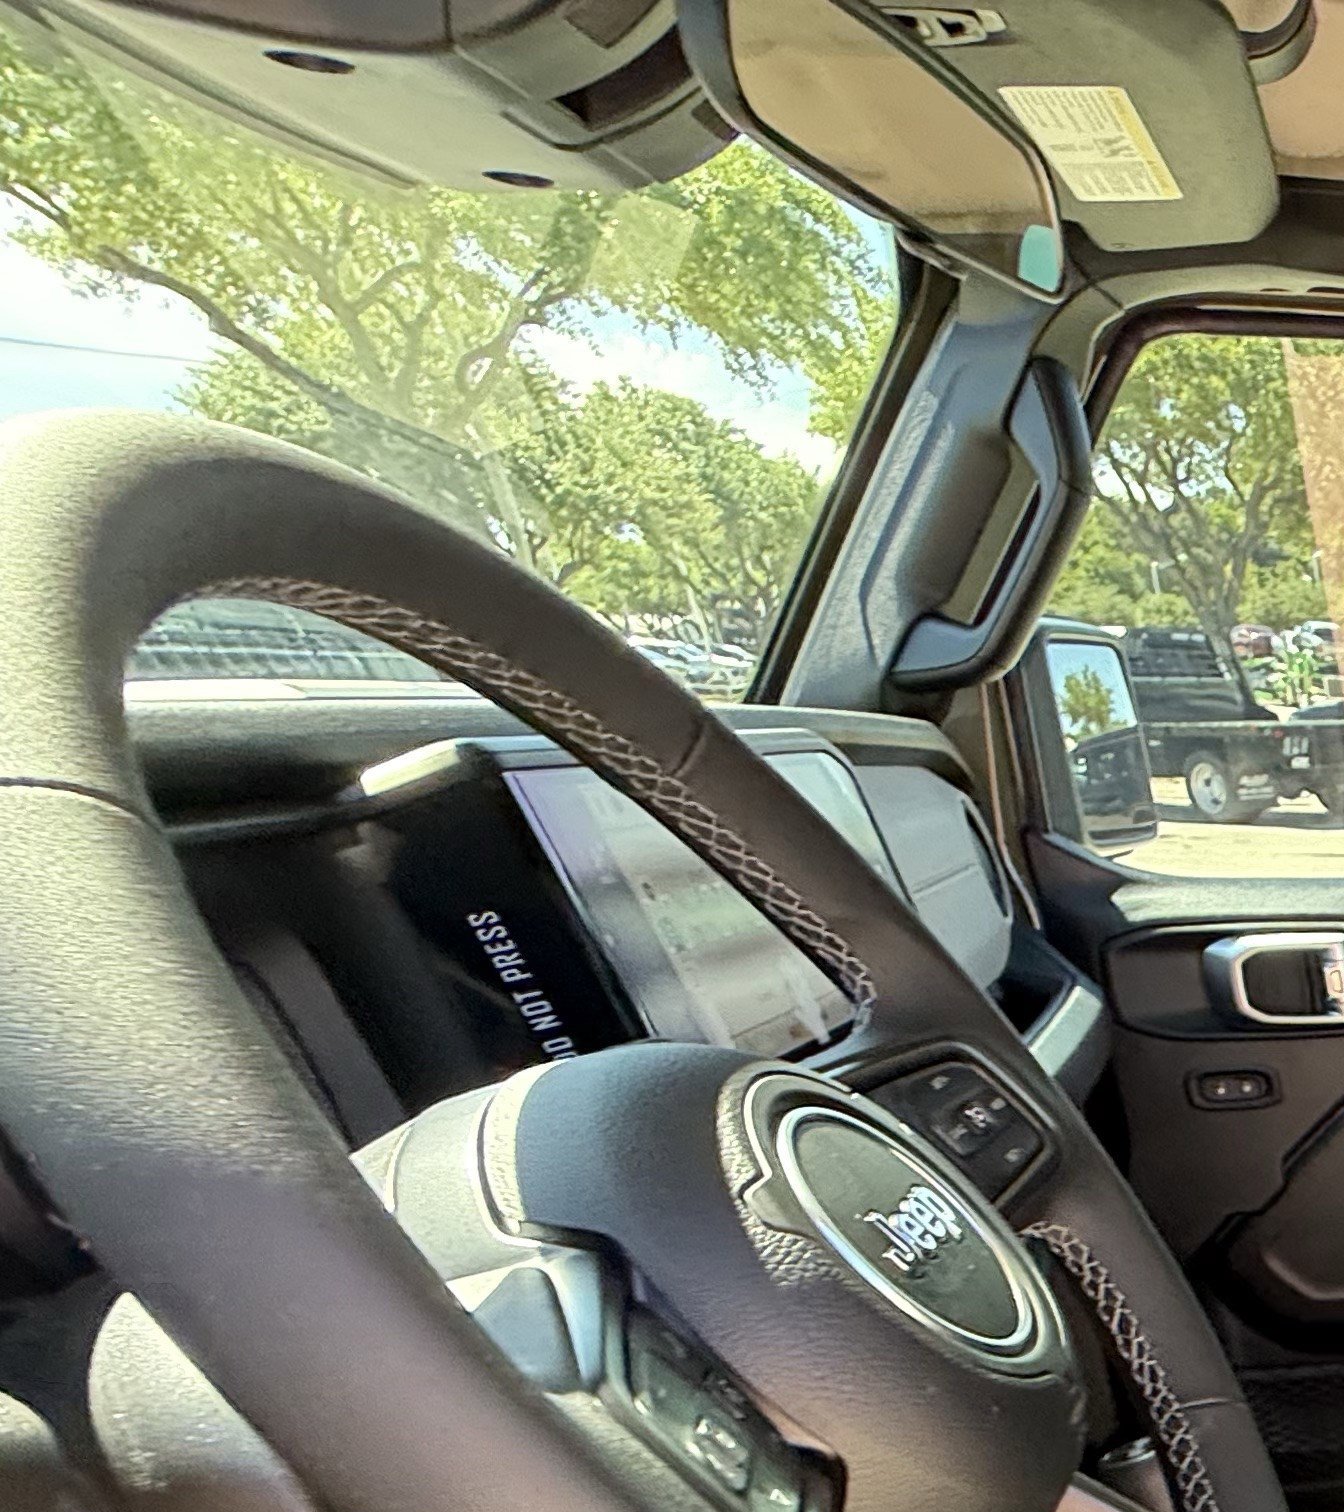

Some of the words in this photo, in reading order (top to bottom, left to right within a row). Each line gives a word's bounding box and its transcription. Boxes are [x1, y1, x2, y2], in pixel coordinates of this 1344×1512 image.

[467, 910, 534, 983] PRESS
[512, 990, 564, 1032] NOT
[863, 1186, 962, 1271] Jeep
